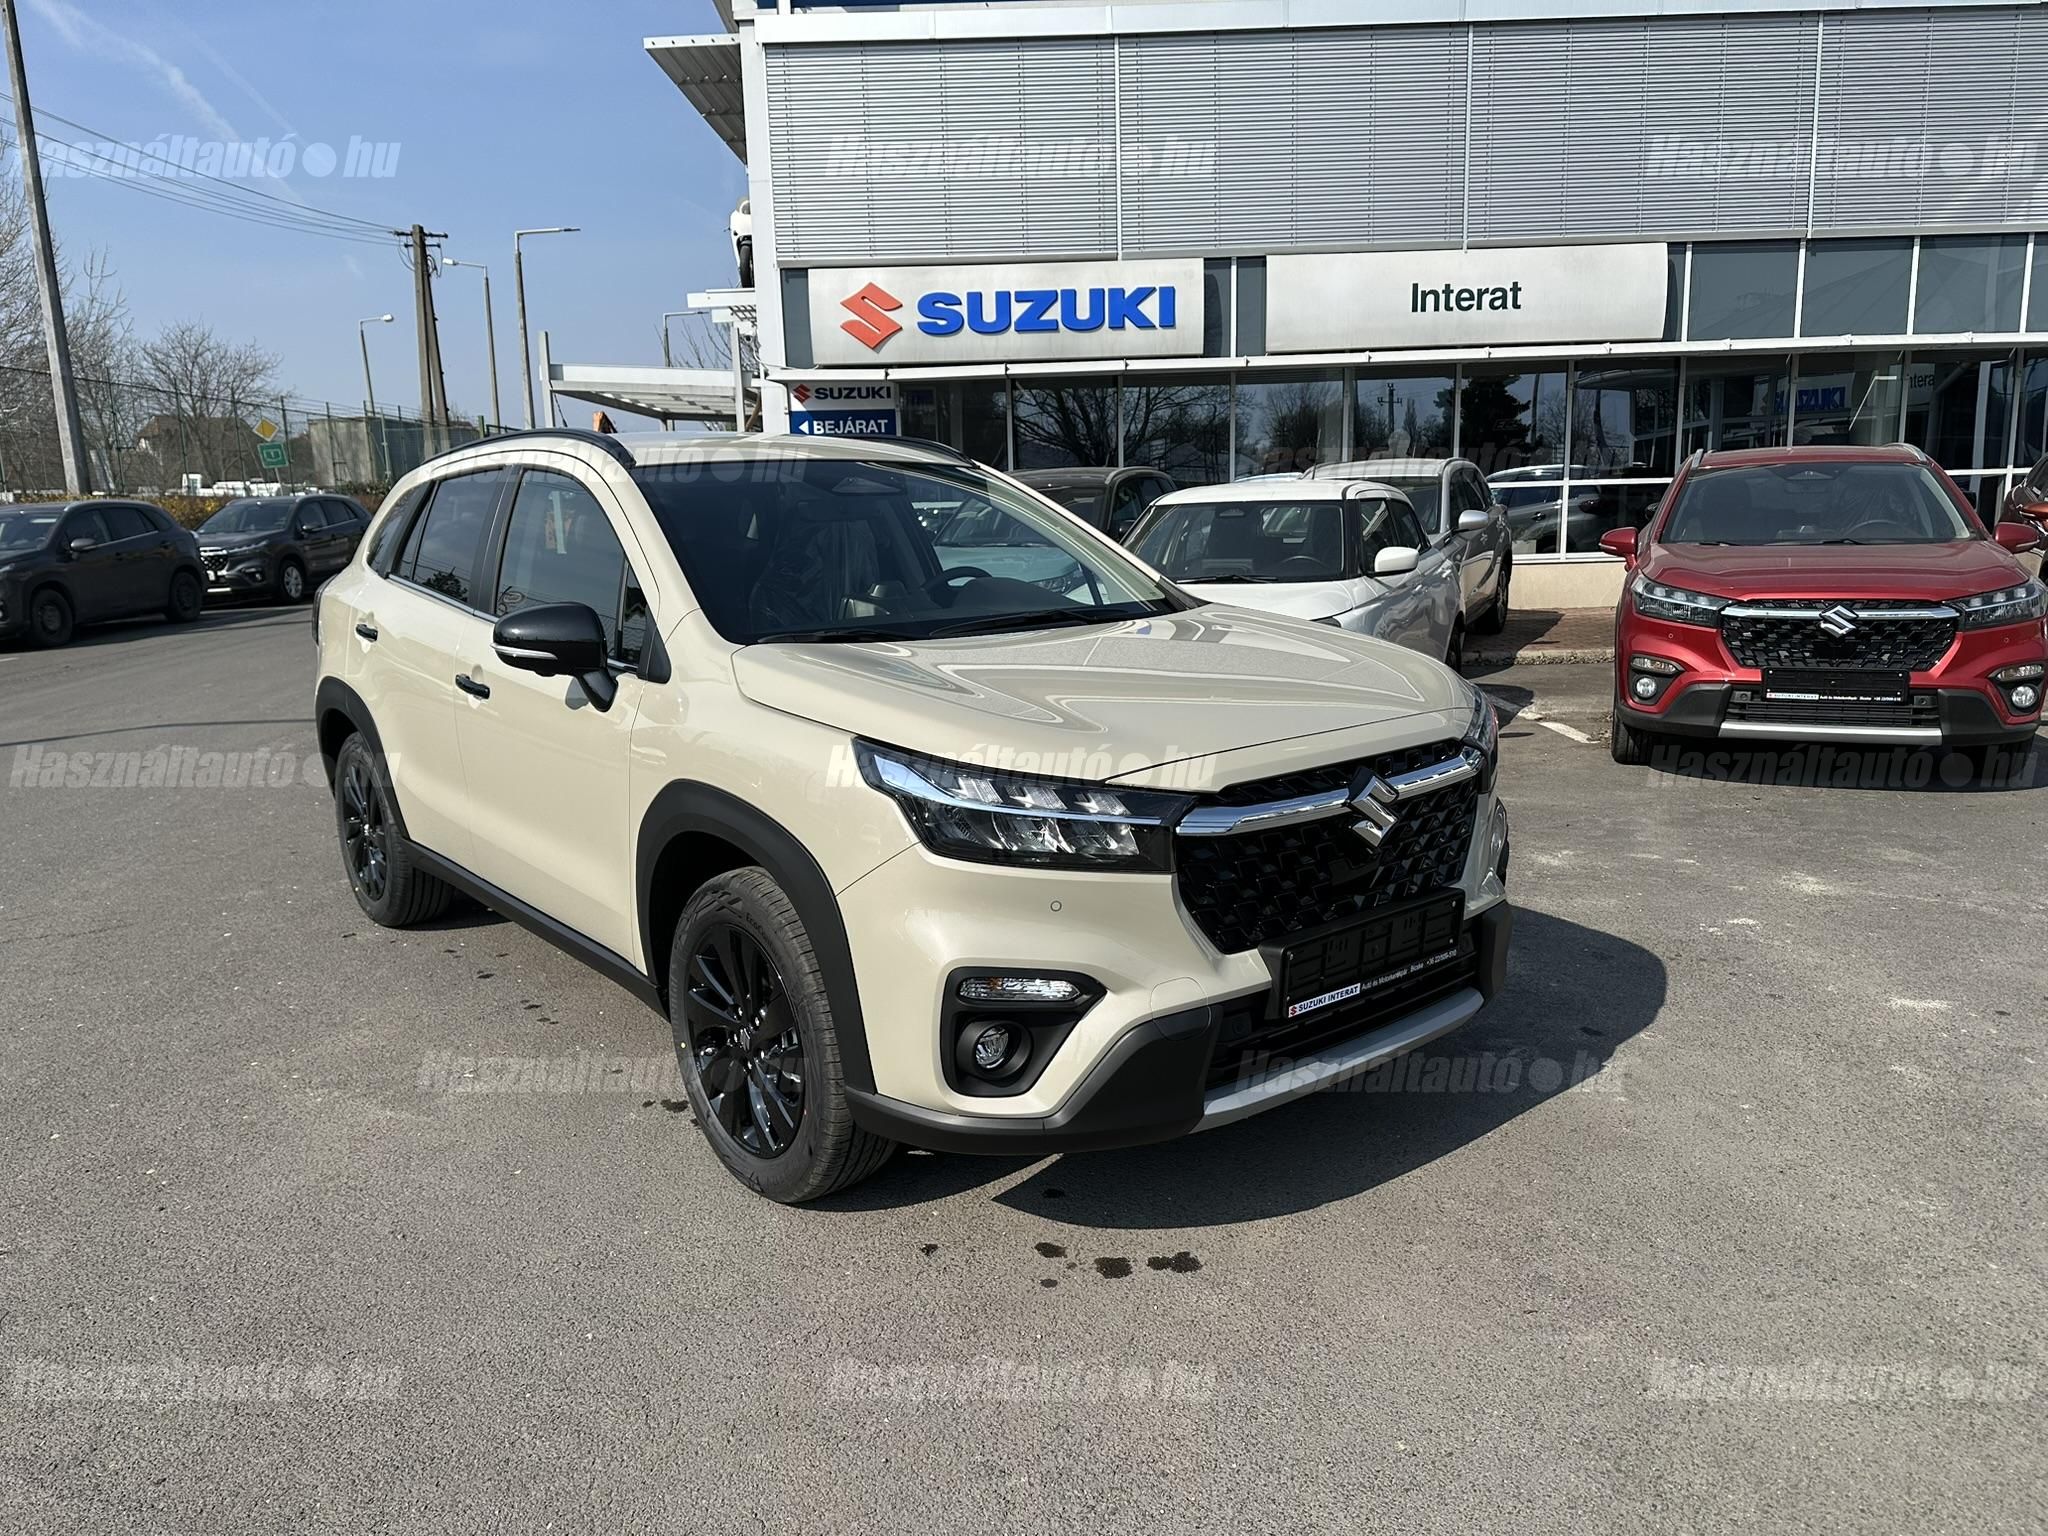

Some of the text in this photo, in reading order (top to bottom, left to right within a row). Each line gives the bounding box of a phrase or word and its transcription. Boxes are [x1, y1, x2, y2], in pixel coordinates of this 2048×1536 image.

[917, 285, 1176, 335] SUZUKI
[1411, 281, 1522, 313] Interat
[814, 386, 892, 400] SUZUKI
[813, 416, 888, 435] BEJÁRAT
[1298, 997, 1326, 1012] SUZUKI
[1328, 985, 1359, 1001] INTERAT
